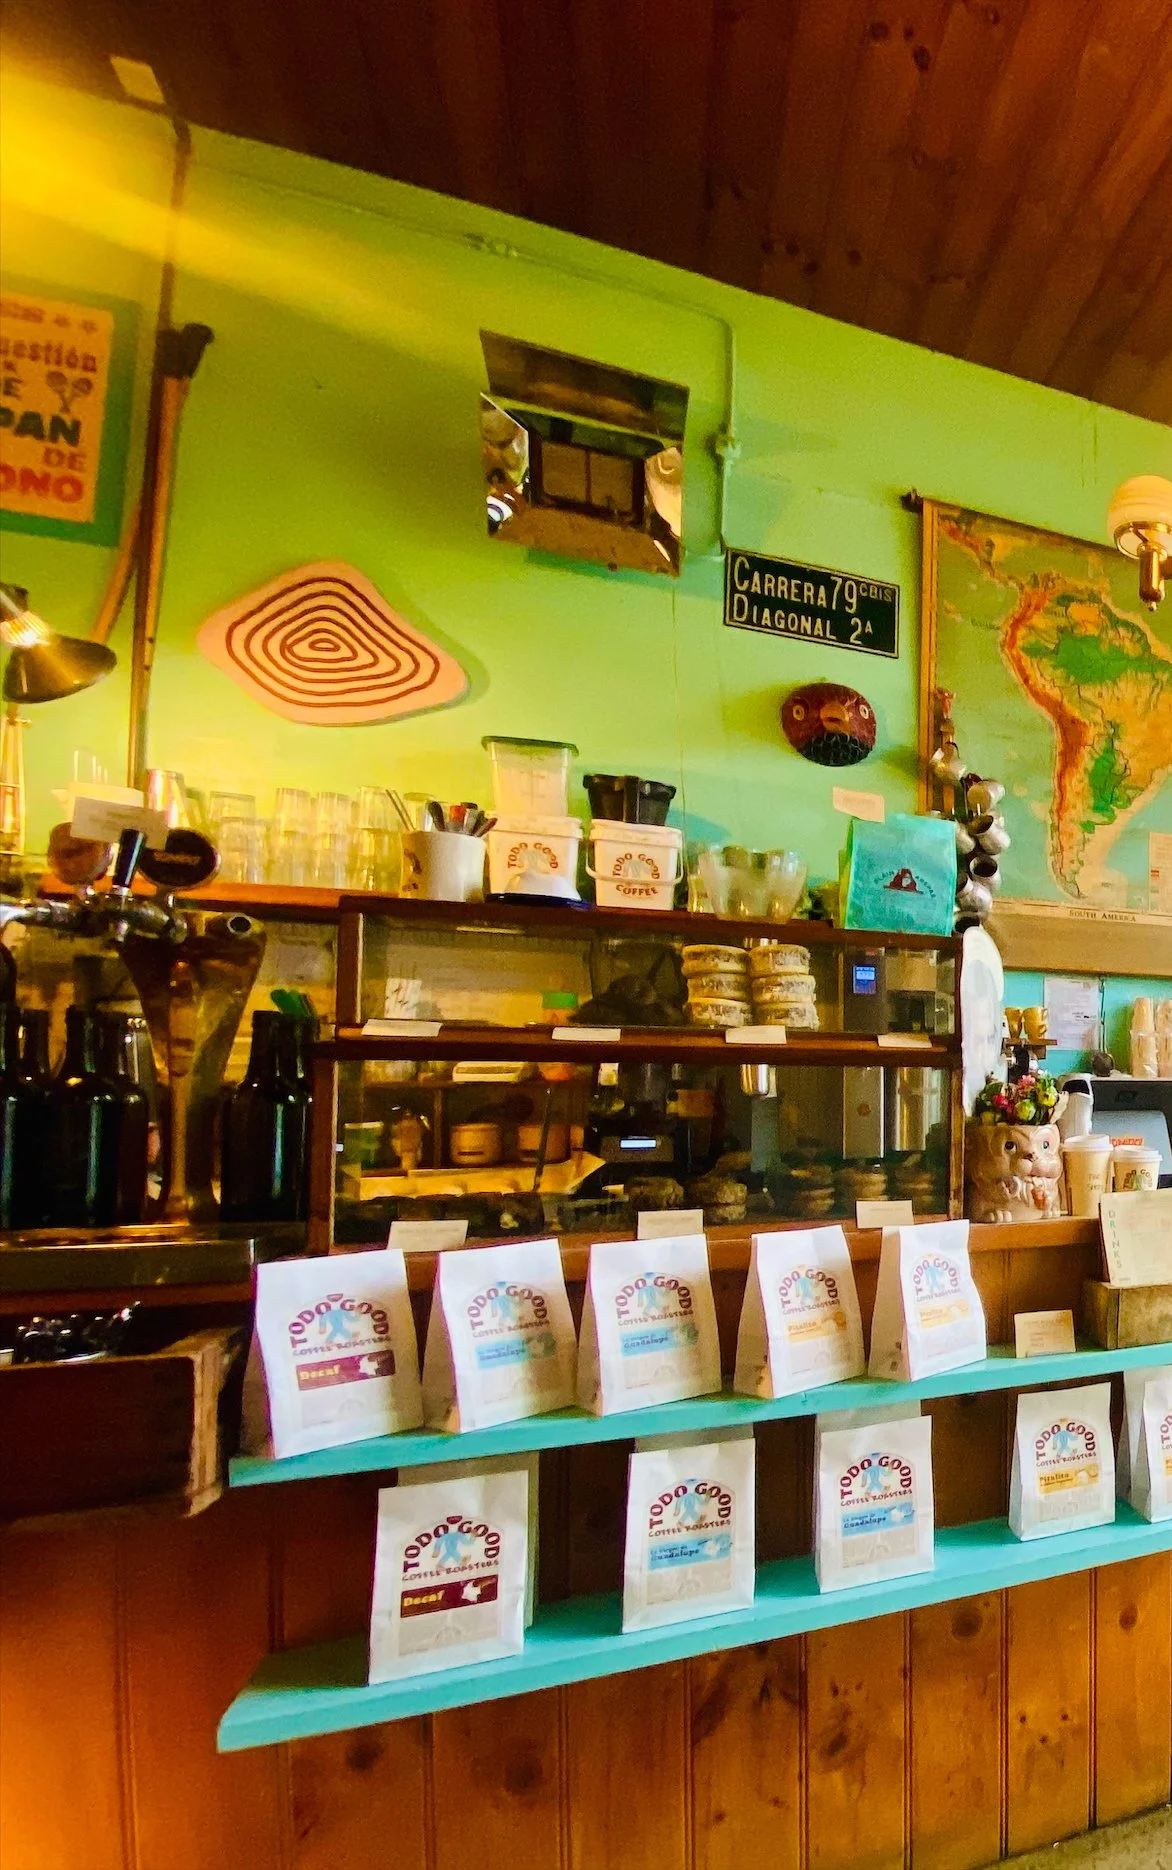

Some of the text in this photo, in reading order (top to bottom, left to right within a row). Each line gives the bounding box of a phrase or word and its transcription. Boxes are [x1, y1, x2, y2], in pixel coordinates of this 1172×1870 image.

[733, 556, 827, 608] CARRERA
[733, 593, 837, 640] DIAGONAL
[507, 842, 559, 869] TODO GOOD
[612, 852, 660, 880] TODO GOOD
[616, 884, 658, 896] COFFEE
[1069, 909, 1137, 922] SOUTH AMERICA
[1108, 1209, 1122, 1269] DRINKS
[615, 1276, 692, 1319] TODO GOOD
[779, 1268, 839, 1309] TODO GOOD
[913, 1257, 959, 1296] TODO GOOD
[288, 1298, 390, 1348] TODO GOOD
[467, 1285, 548, 1330] TODO GOOD
[300, 1364, 340, 1381] Decaf
[1035, 1422, 1096, 1460] TODO GOOD
[840, 1455, 912, 1499] TODO GOOD
[648, 1482, 732, 1529] TODO GOOD
[403, 1520, 501, 1573] TODO GOOD
[403, 1590, 445, 1607] Decaf
